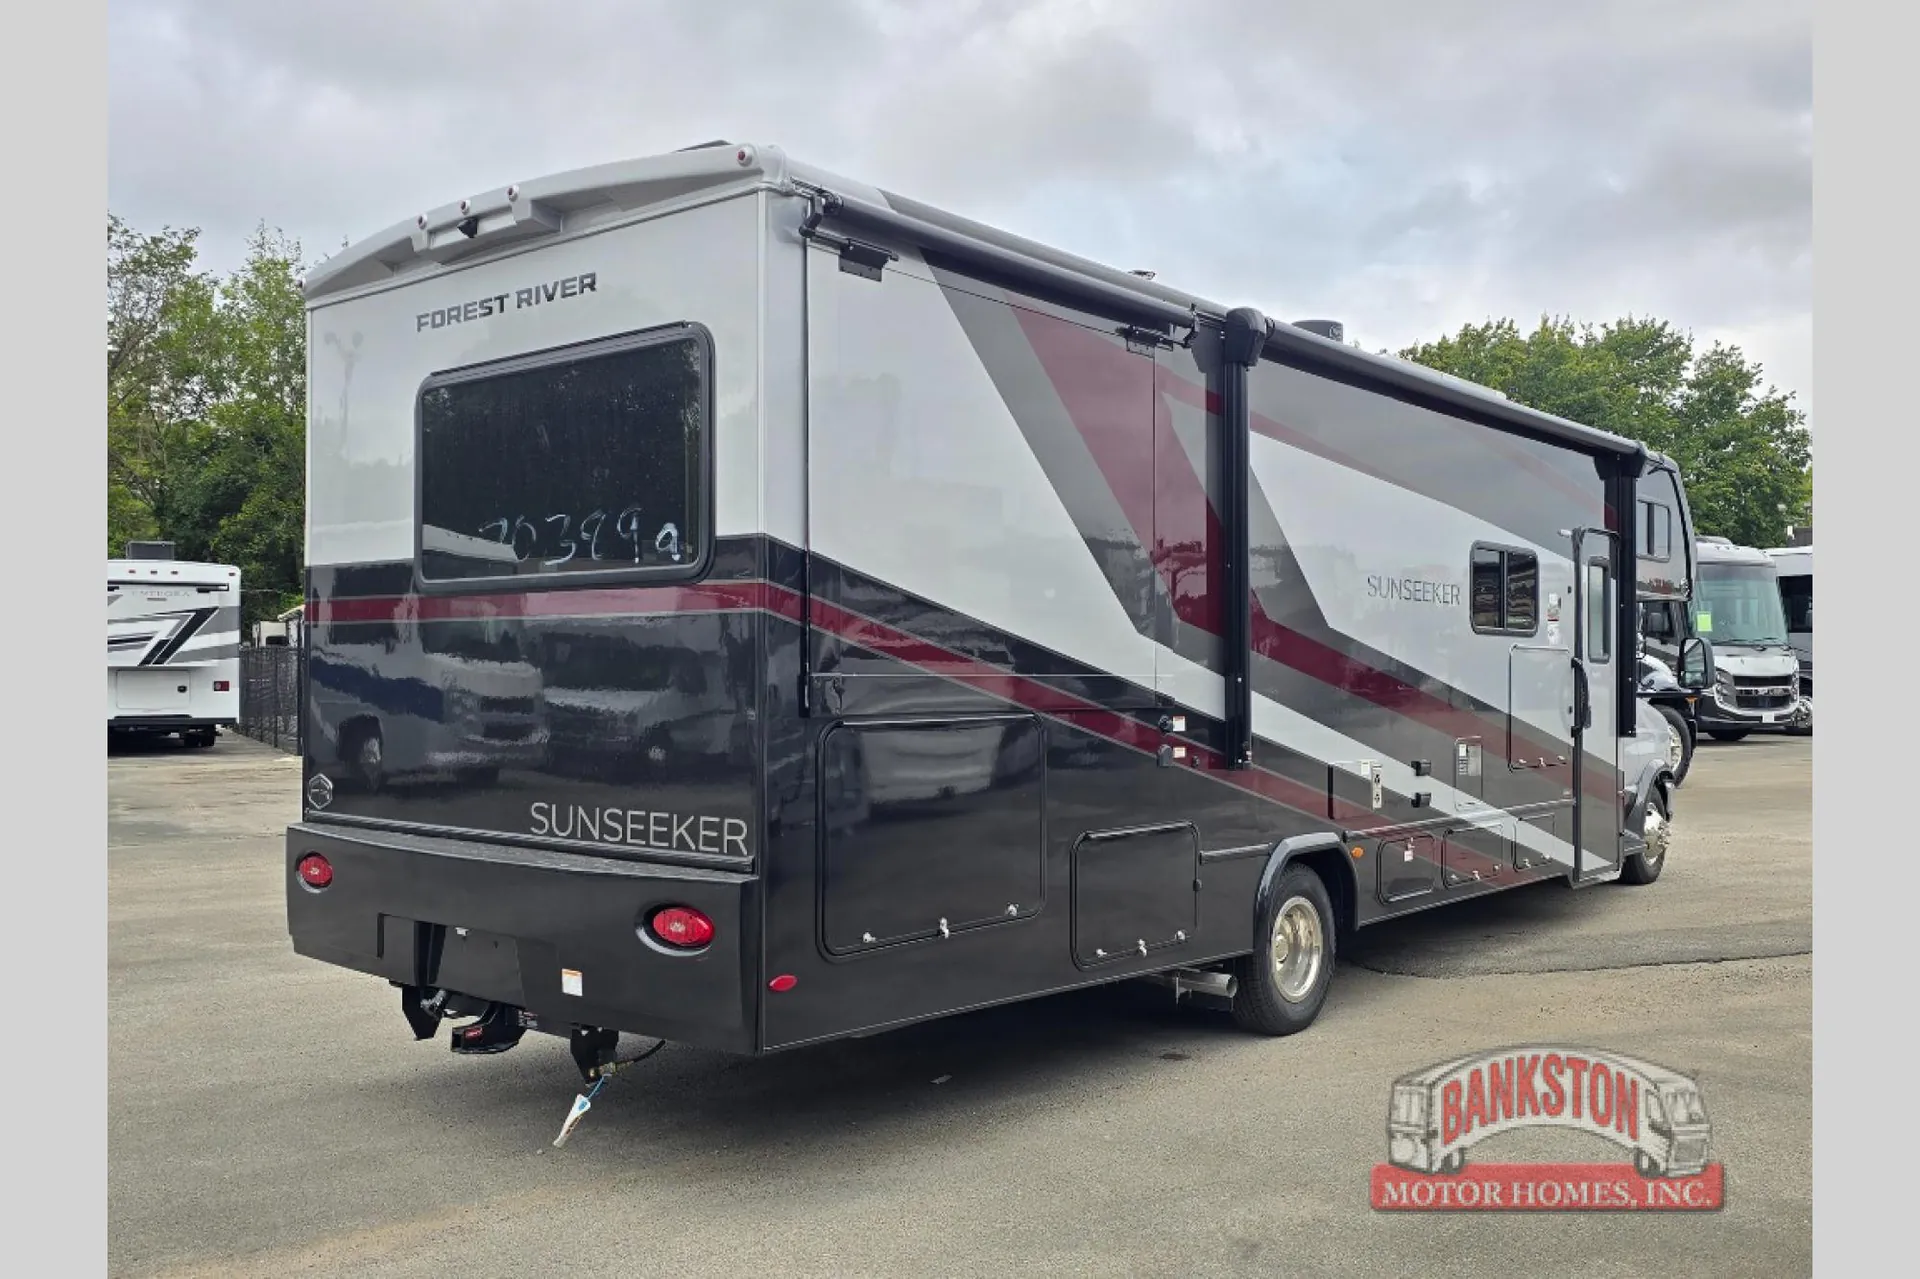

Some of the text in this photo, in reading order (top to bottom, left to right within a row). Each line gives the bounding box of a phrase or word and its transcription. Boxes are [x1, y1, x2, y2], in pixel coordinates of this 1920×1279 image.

[416, 272, 597, 332] FOREST RIVER
[1367, 575, 1460, 605] SUNSEEKER
[530, 802, 748, 855] SUNSEEKER
